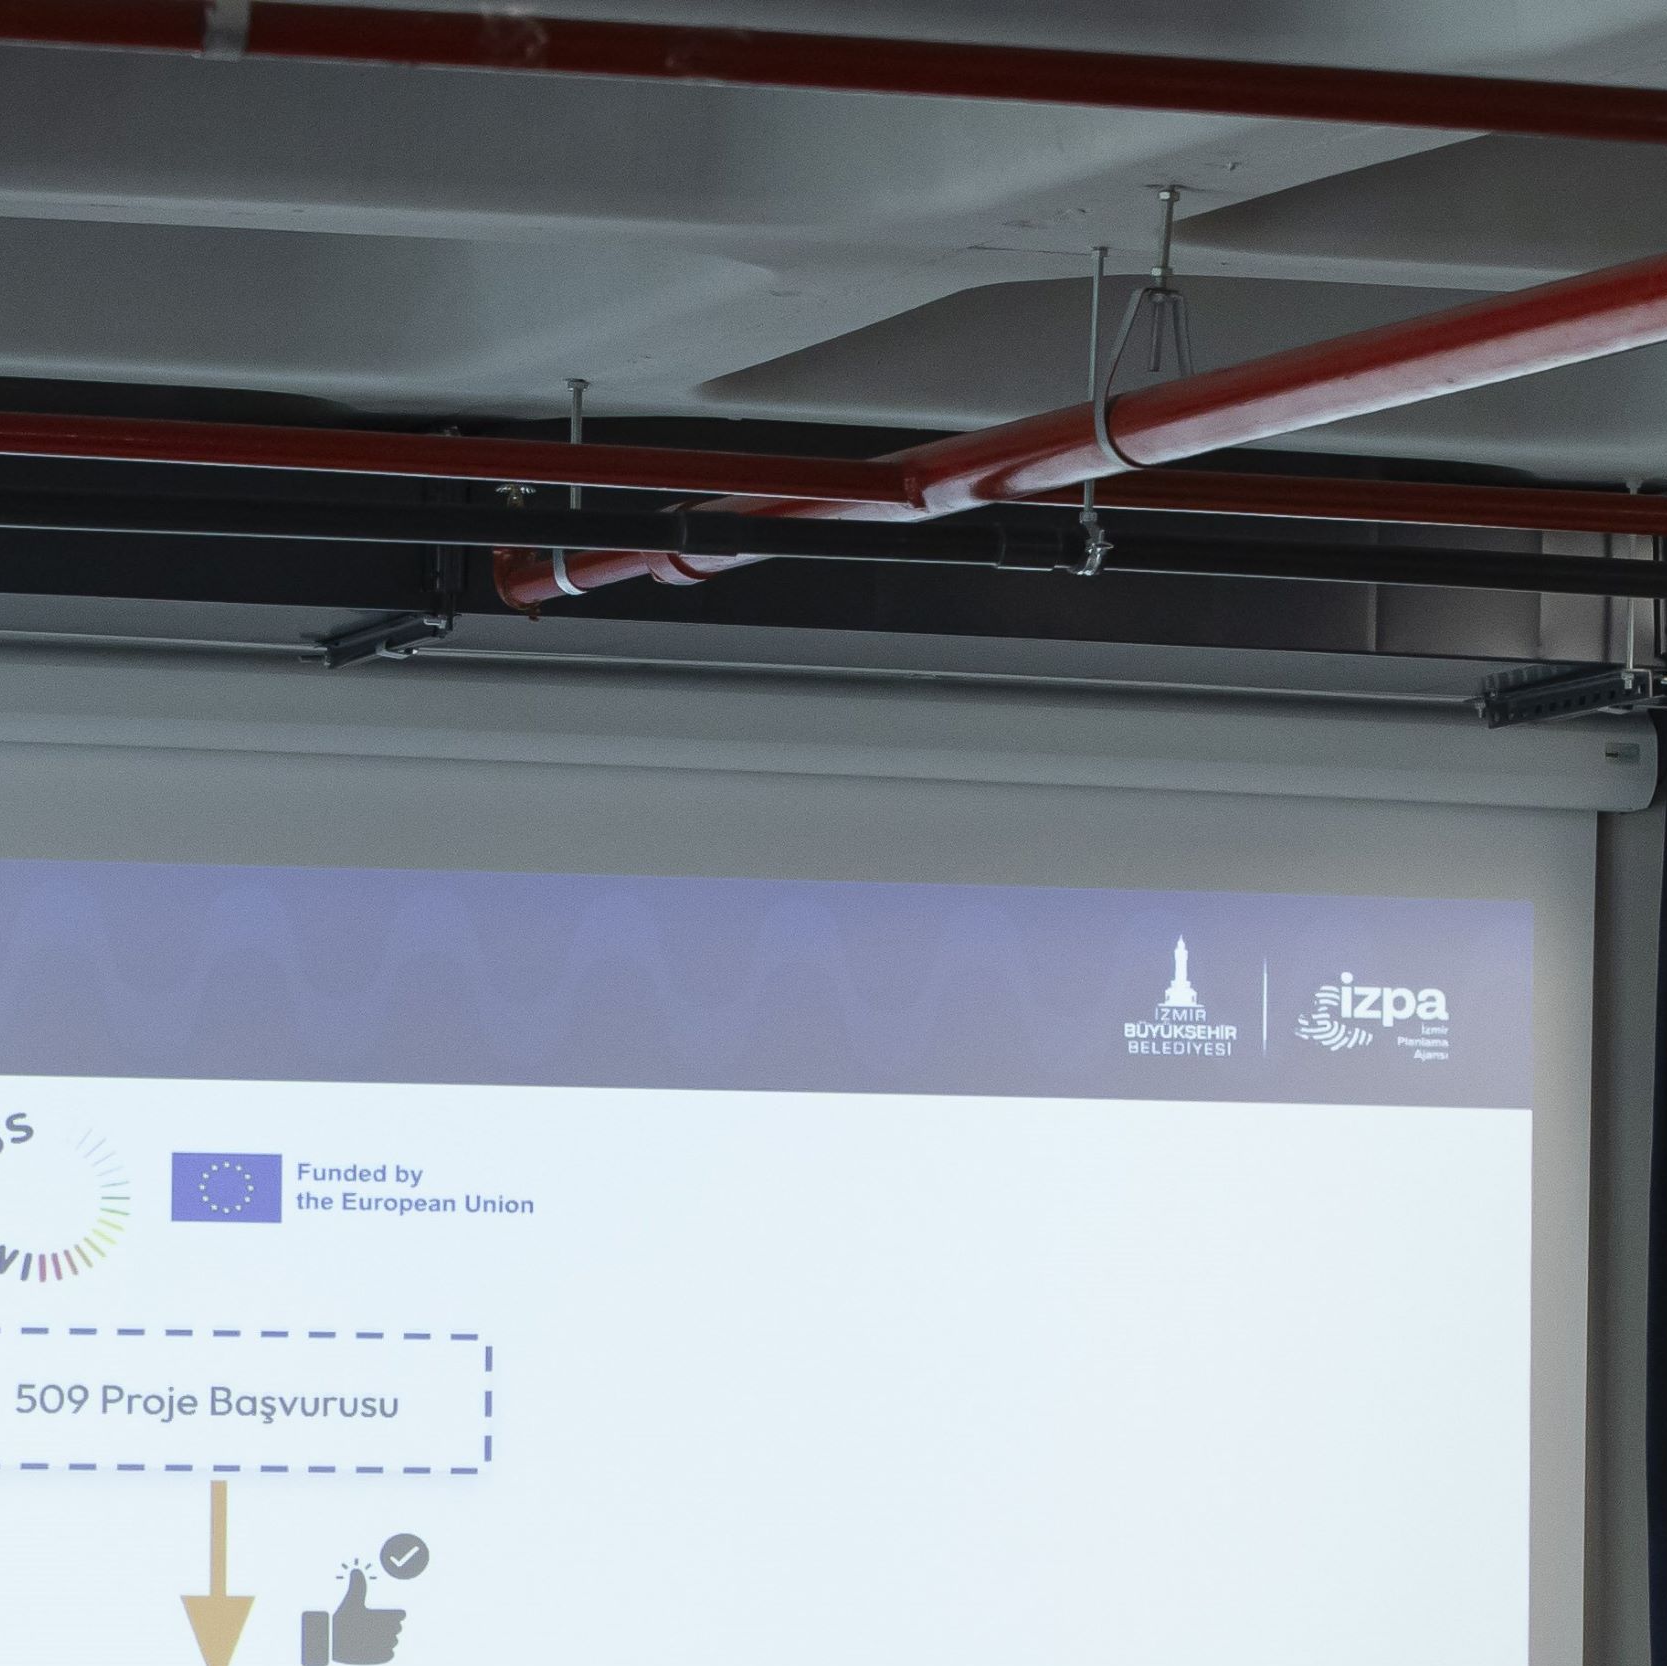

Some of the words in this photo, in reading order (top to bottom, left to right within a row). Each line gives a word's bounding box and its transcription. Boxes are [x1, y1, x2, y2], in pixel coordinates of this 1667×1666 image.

[1340, 971, 1450, 1028] izpa
[297, 1162, 387, 1183] Funded
[395, 1164, 424, 1188] by
[296, 1191, 334, 1211] the
[342, 1192, 456, 1217] European
[465, 1194, 534, 1214] Union
[15, 1383, 90, 1415] 509
[101, 1384, 199, 1424] Proje
[210, 1386, 399, 1425] Başvurusu
